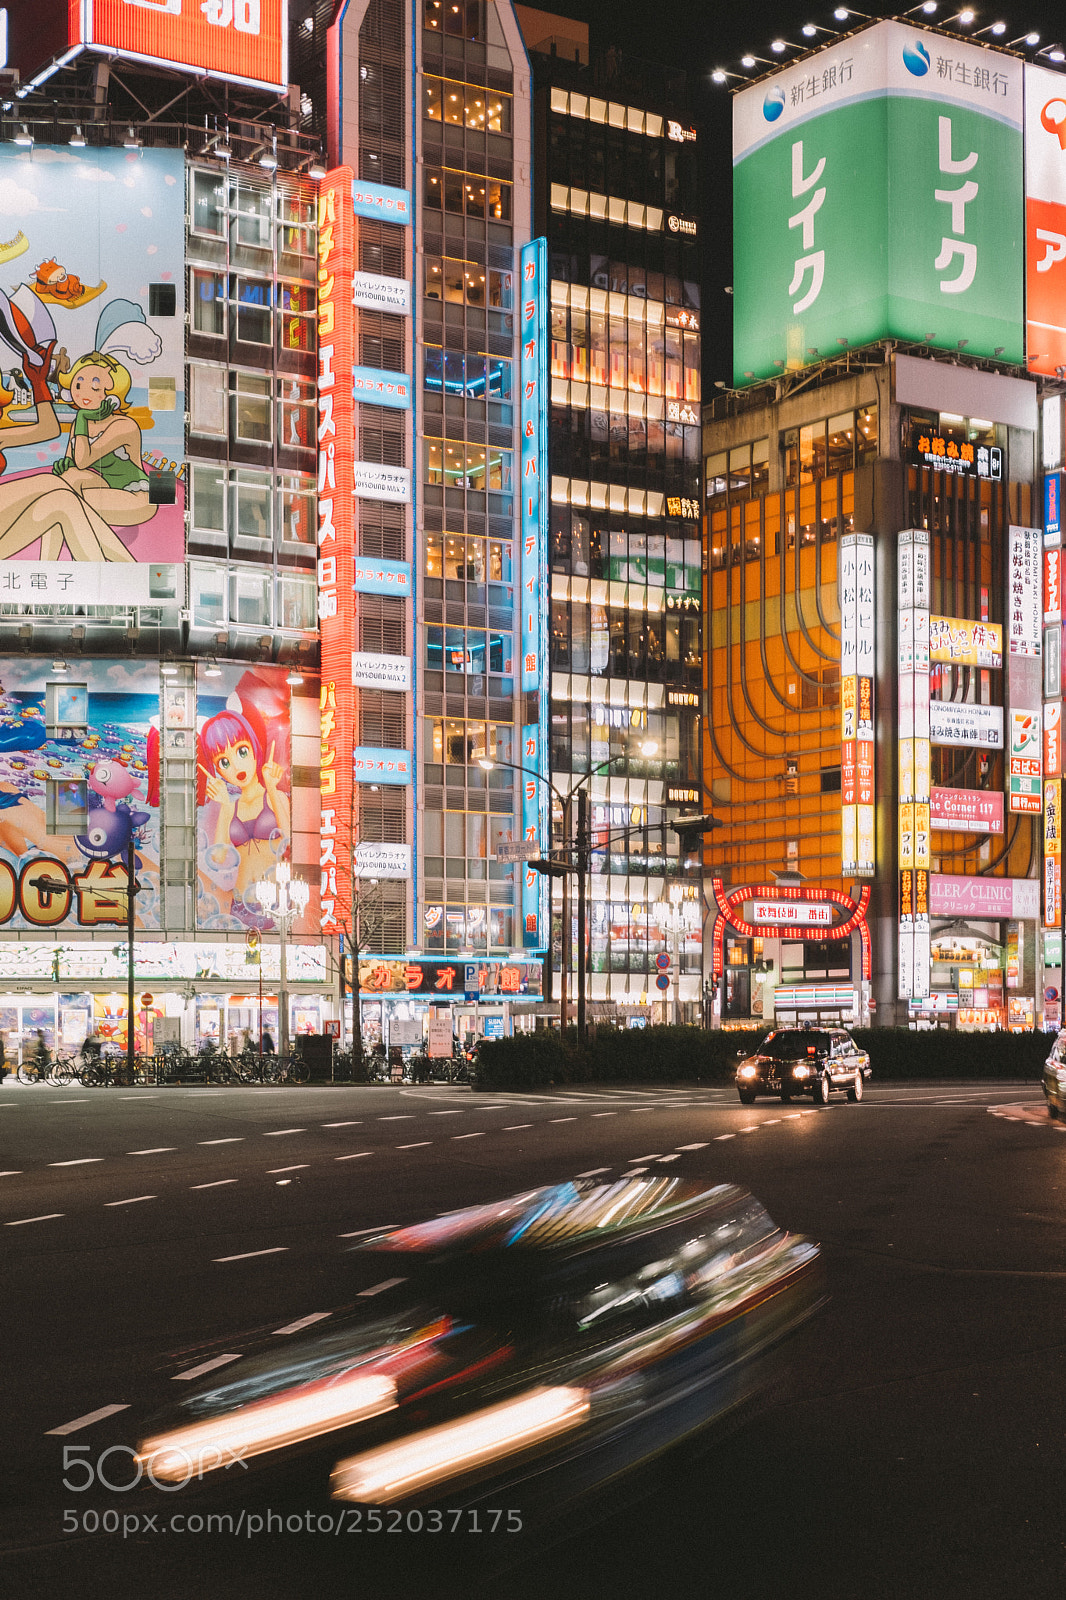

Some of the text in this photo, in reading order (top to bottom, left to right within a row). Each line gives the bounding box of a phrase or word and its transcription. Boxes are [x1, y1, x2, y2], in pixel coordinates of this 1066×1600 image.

[790, 58, 854, 107] 新生銀行
[936, 56, 1008, 97] 新生銀行
[355, 191, 407, 212] カラオケ館
[935, 115, 978, 293] レイク
[789, 140, 826, 314] レイク
[318, 188, 335, 336] パチンコ
[401, 297, 406, 306] 2
[355, 378, 407, 397] カラオケ館
[401, 487, 406, 495] 2
[1048, 478, 1057, 522] PROMISE
[682, 508, 699, 519] BAR
[3, 571, 74, 590] 北電子
[355, 568, 407, 585] カラオケ館
[843, 559, 855, 656] 小松ビル
[859, 559, 872, 655] 小松ビル
[972, 624, 997, 647] 焼き
[950, 642, 971, 658] たこ
[401, 674, 406, 683] 2
[355, 758, 408, 773] カラオケ館
[1012, 759, 1039, 774] たばこ
[1019, 777, 1032, 793] 酒
[320, 681, 337, 928] パチンコ エスパス
[845, 790, 854, 802] 4F
[861, 790, 870, 802] 4F
[944, 800, 976, 812] Corner
[979, 803, 993, 816] 117
[991, 820, 1001, 830] 4F
[1046, 802, 1056, 839] 金の蔵
[526, 737, 537, 931] カラオケ館
[1047, 842, 1058, 851] 2F
[401, 863, 406, 871] 2
[424, 906, 485, 929] ダーツ
[466, 966, 475, 980] P
